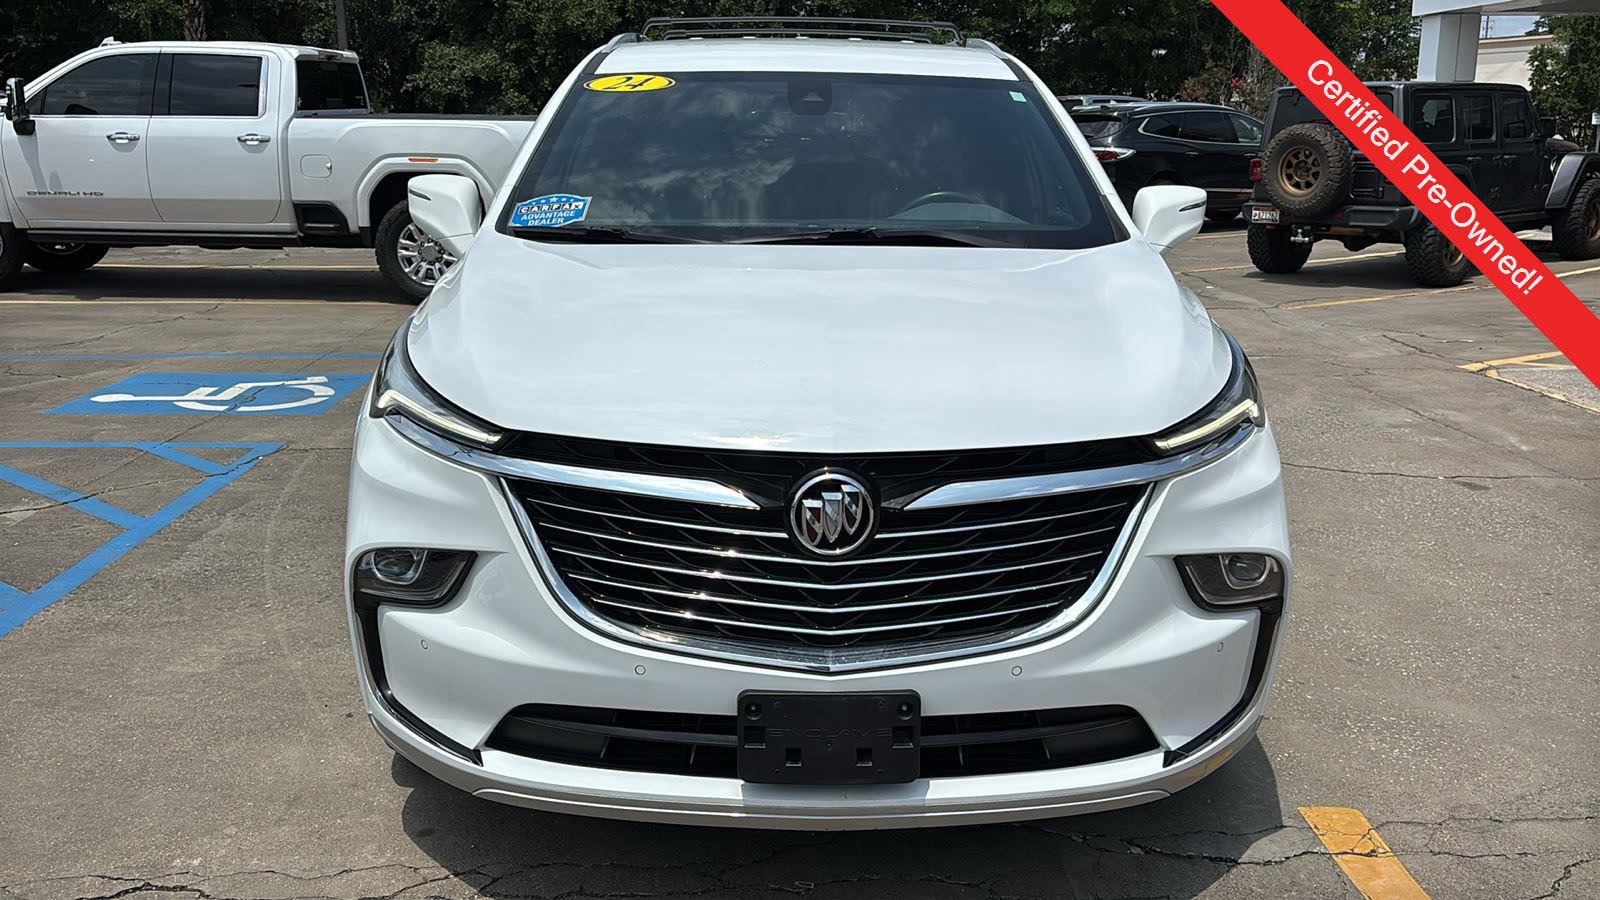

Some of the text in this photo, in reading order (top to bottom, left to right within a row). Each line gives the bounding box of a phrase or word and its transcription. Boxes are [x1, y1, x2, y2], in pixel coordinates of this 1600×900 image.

[602, 75, 657, 90] 24
[519, 202, 584, 214] CARFAX
[521, 211, 576, 221] ADVANTAGE
[527, 217, 565, 226] DEALER
[767, 728, 893, 738] ENCLAVE
